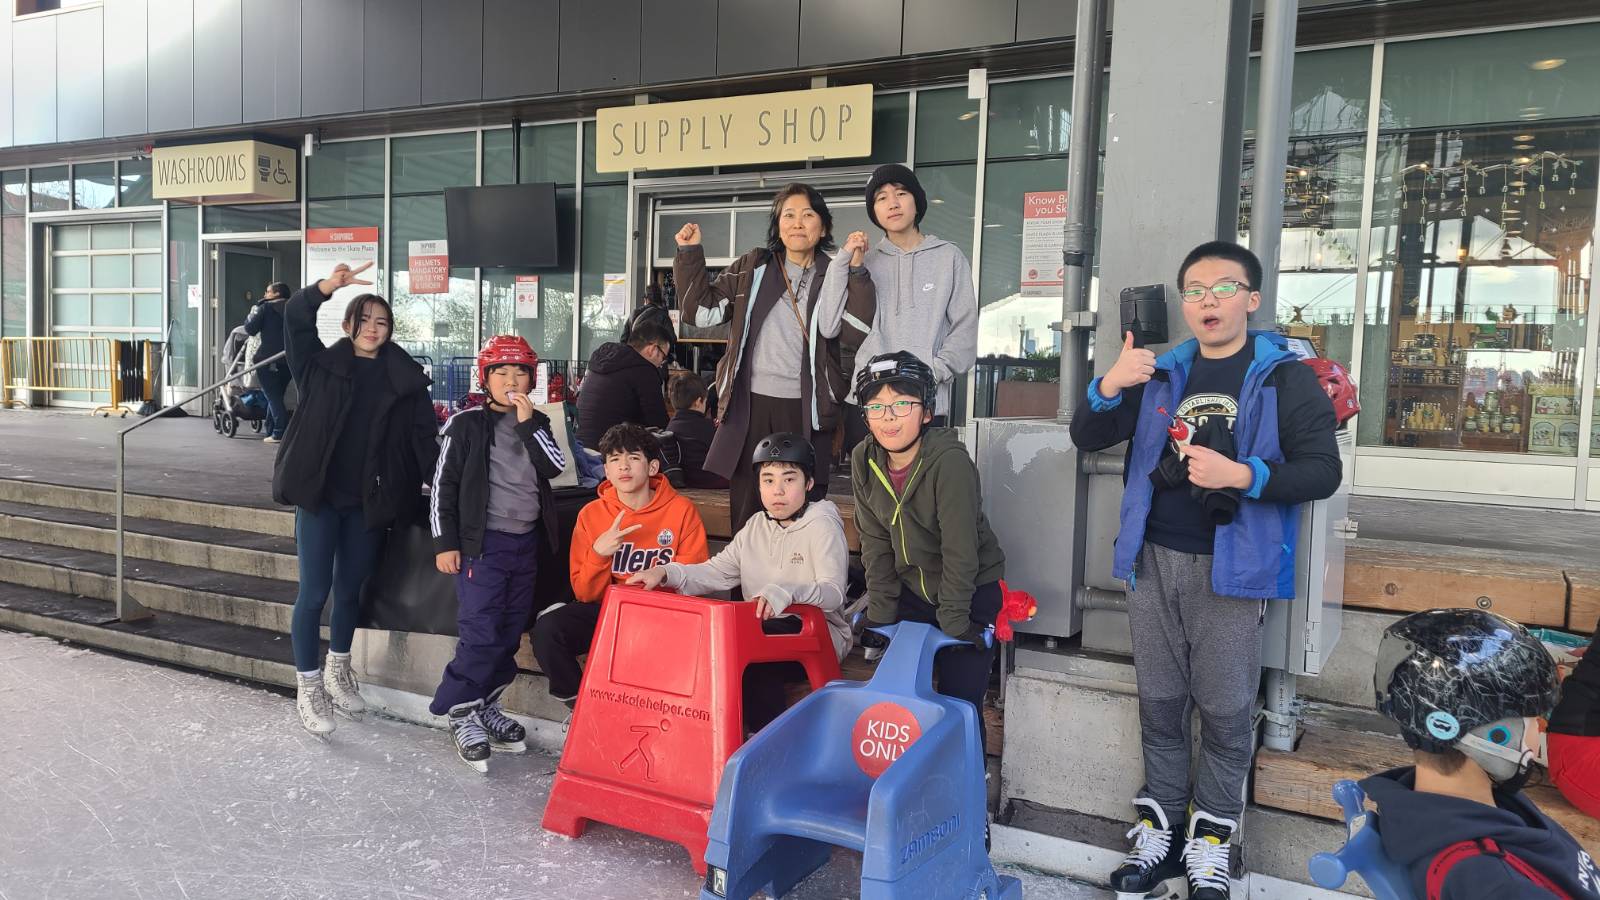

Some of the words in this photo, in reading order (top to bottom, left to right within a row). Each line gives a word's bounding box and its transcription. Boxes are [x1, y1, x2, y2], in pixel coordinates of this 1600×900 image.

[612, 113, 733, 157] SUPPLY
[758, 103, 853, 146] SHOP
[157, 153, 247, 187] WASHROOMS
[1028, 195, 1056, 205] Know
[1035, 206, 1053, 217] you
[409, 266, 447, 274] MANDATORY
[414, 258, 441, 266] HELMETS
[612, 542, 675, 575] ilers
[866, 719, 911, 743] KIDS
